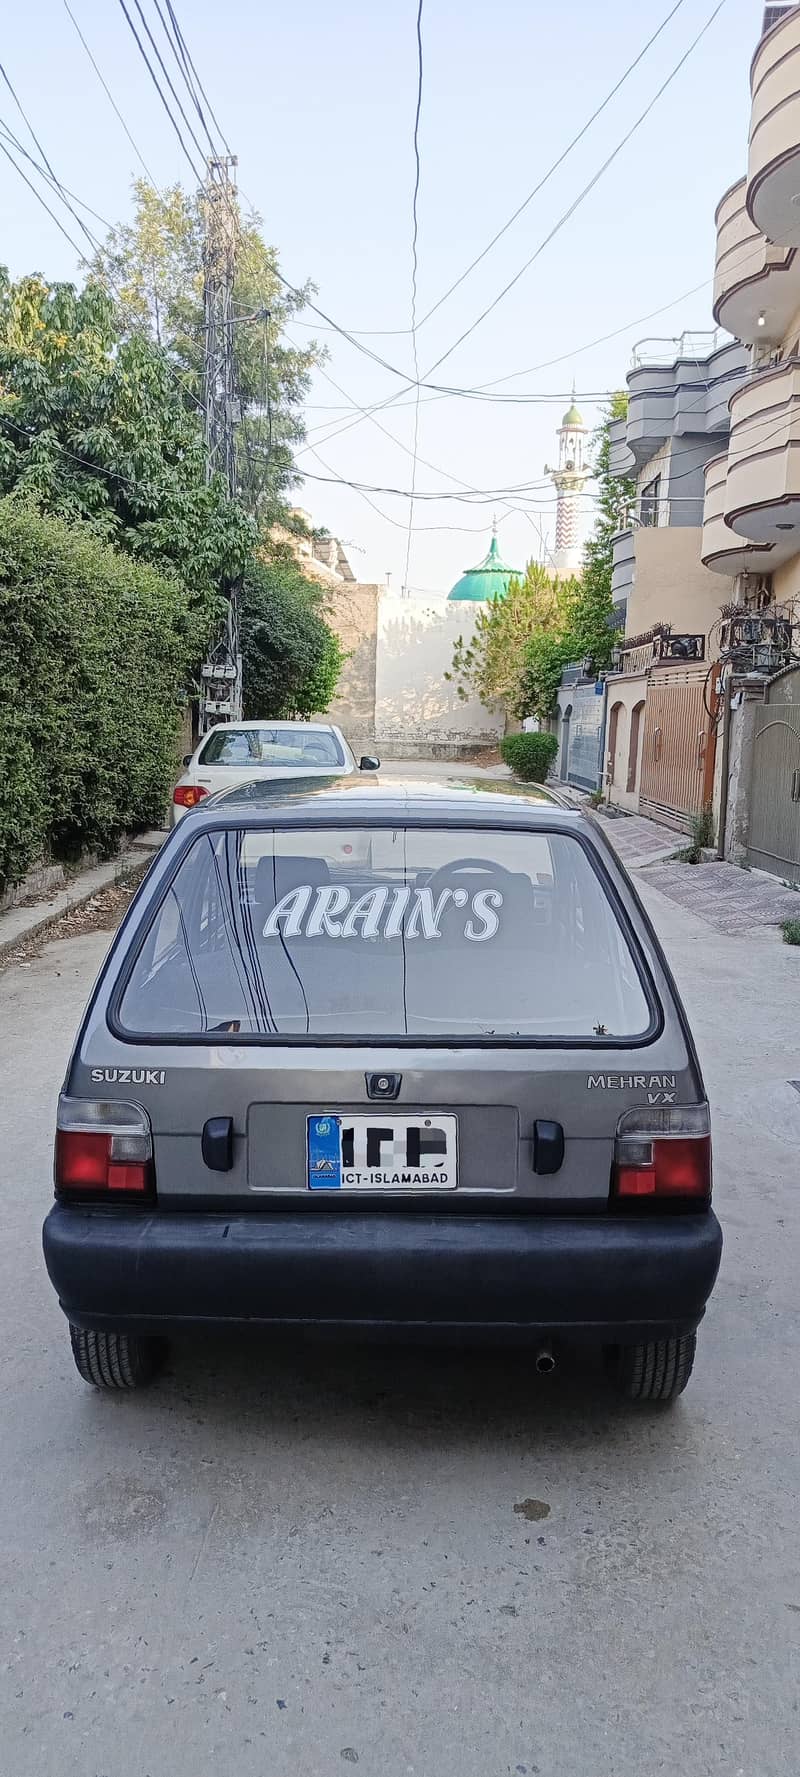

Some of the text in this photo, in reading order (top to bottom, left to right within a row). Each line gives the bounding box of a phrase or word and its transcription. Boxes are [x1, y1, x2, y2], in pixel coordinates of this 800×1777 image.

[262, 885, 503, 942] ARAIN'S
[91, 1069, 166, 1085] SUZUKI
[587, 1074, 676, 1089] MEHRAN
[647, 1092, 676, 1104] VX
[341, 1173, 448, 1184] ICT-ISLAMABAD
